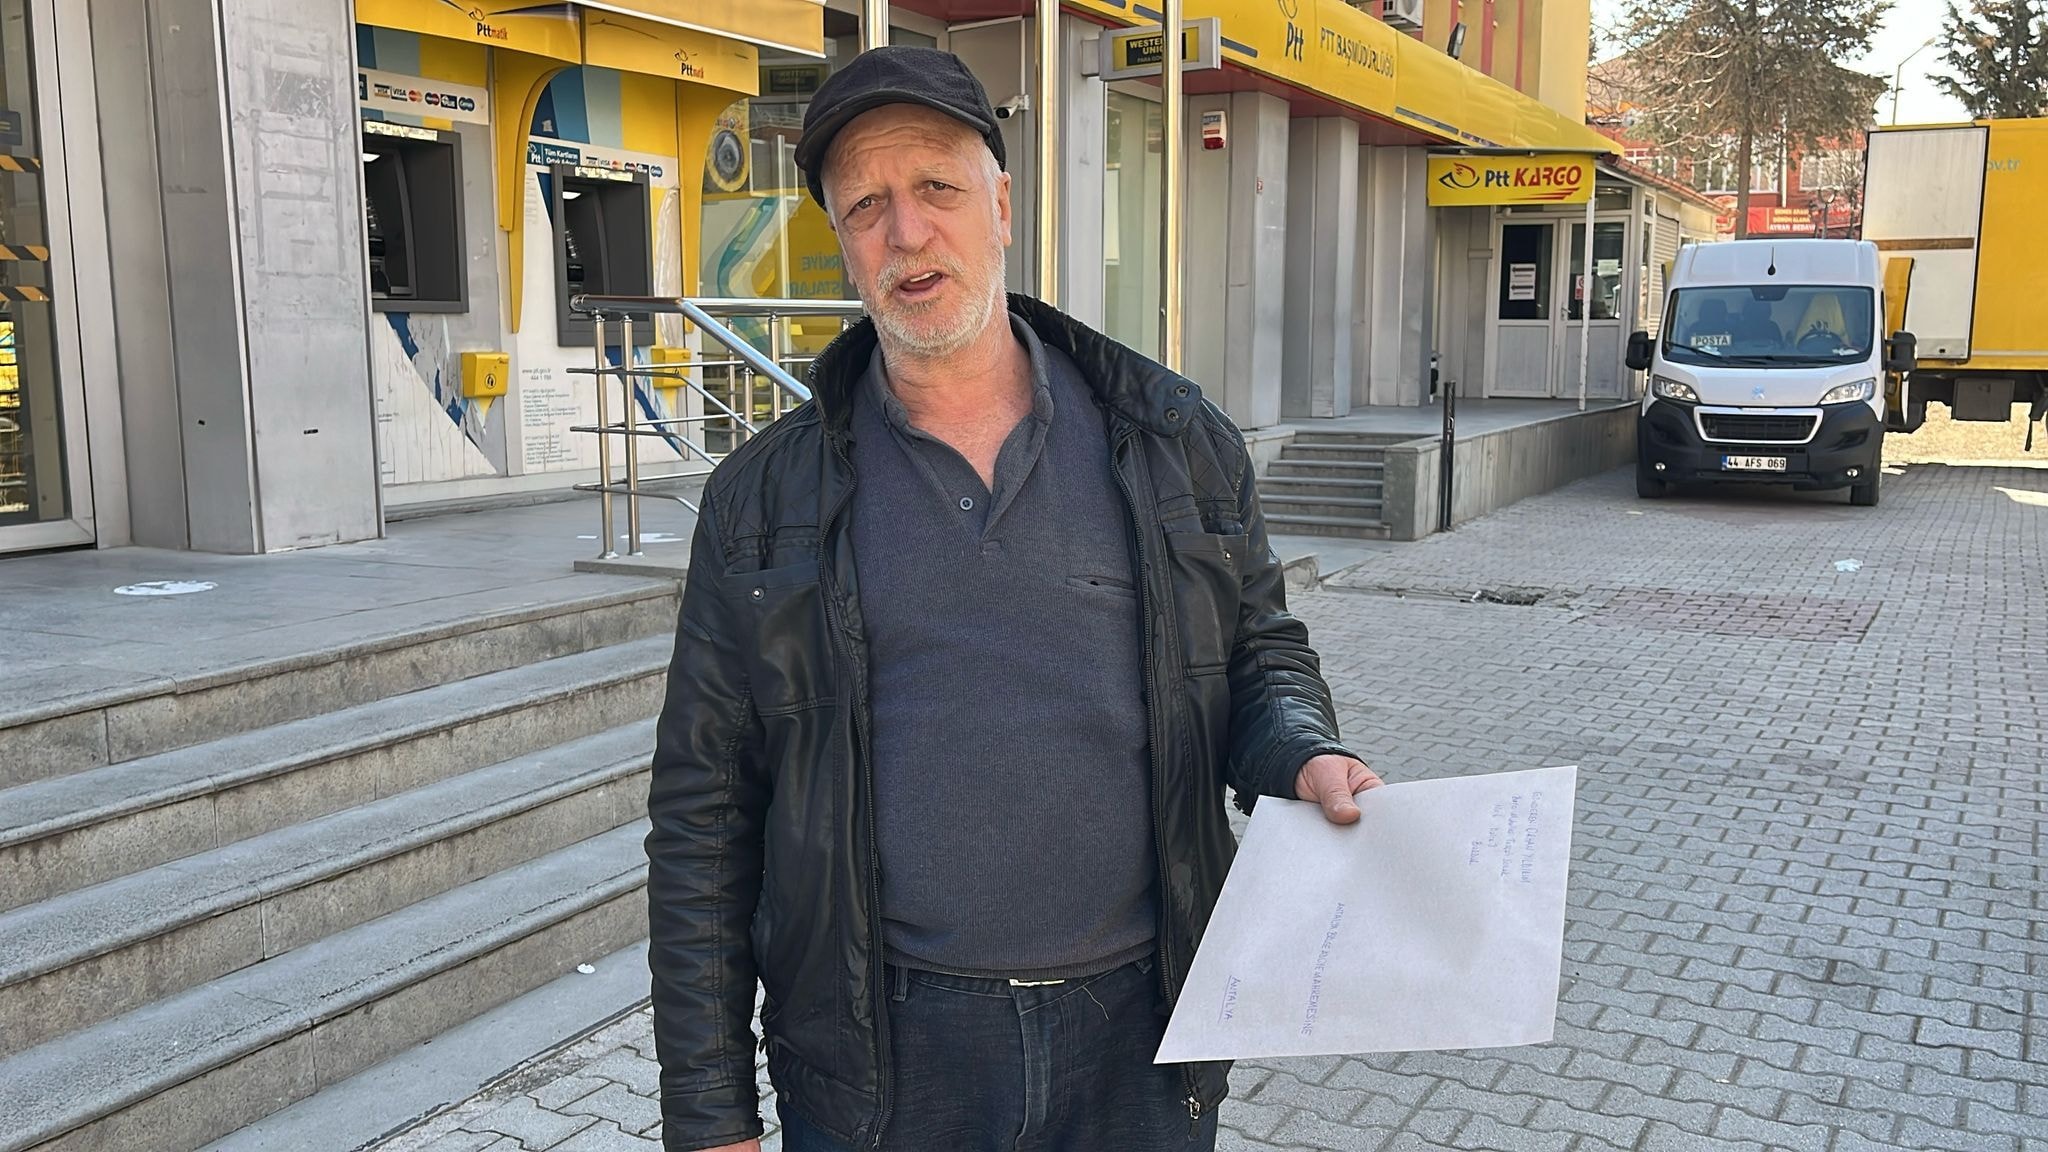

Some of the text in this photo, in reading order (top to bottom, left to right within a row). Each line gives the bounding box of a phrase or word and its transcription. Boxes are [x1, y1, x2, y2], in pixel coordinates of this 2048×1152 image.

[1129, 37, 1163, 49] WESTE
[1285, 21, 1304, 62] Ptt
[1320, 26, 1335, 53] PTT
[1142, 46, 1163, 55] UNI
[393, 88, 407, 97] VISA
[1485, 165, 1582, 187] Ptt KARGO
[1695, 335, 1728, 345] POSTA
[1728, 458, 1785, 468] 44 AFS 069
[1223, 976, 1241, 1021] ANTALYA
